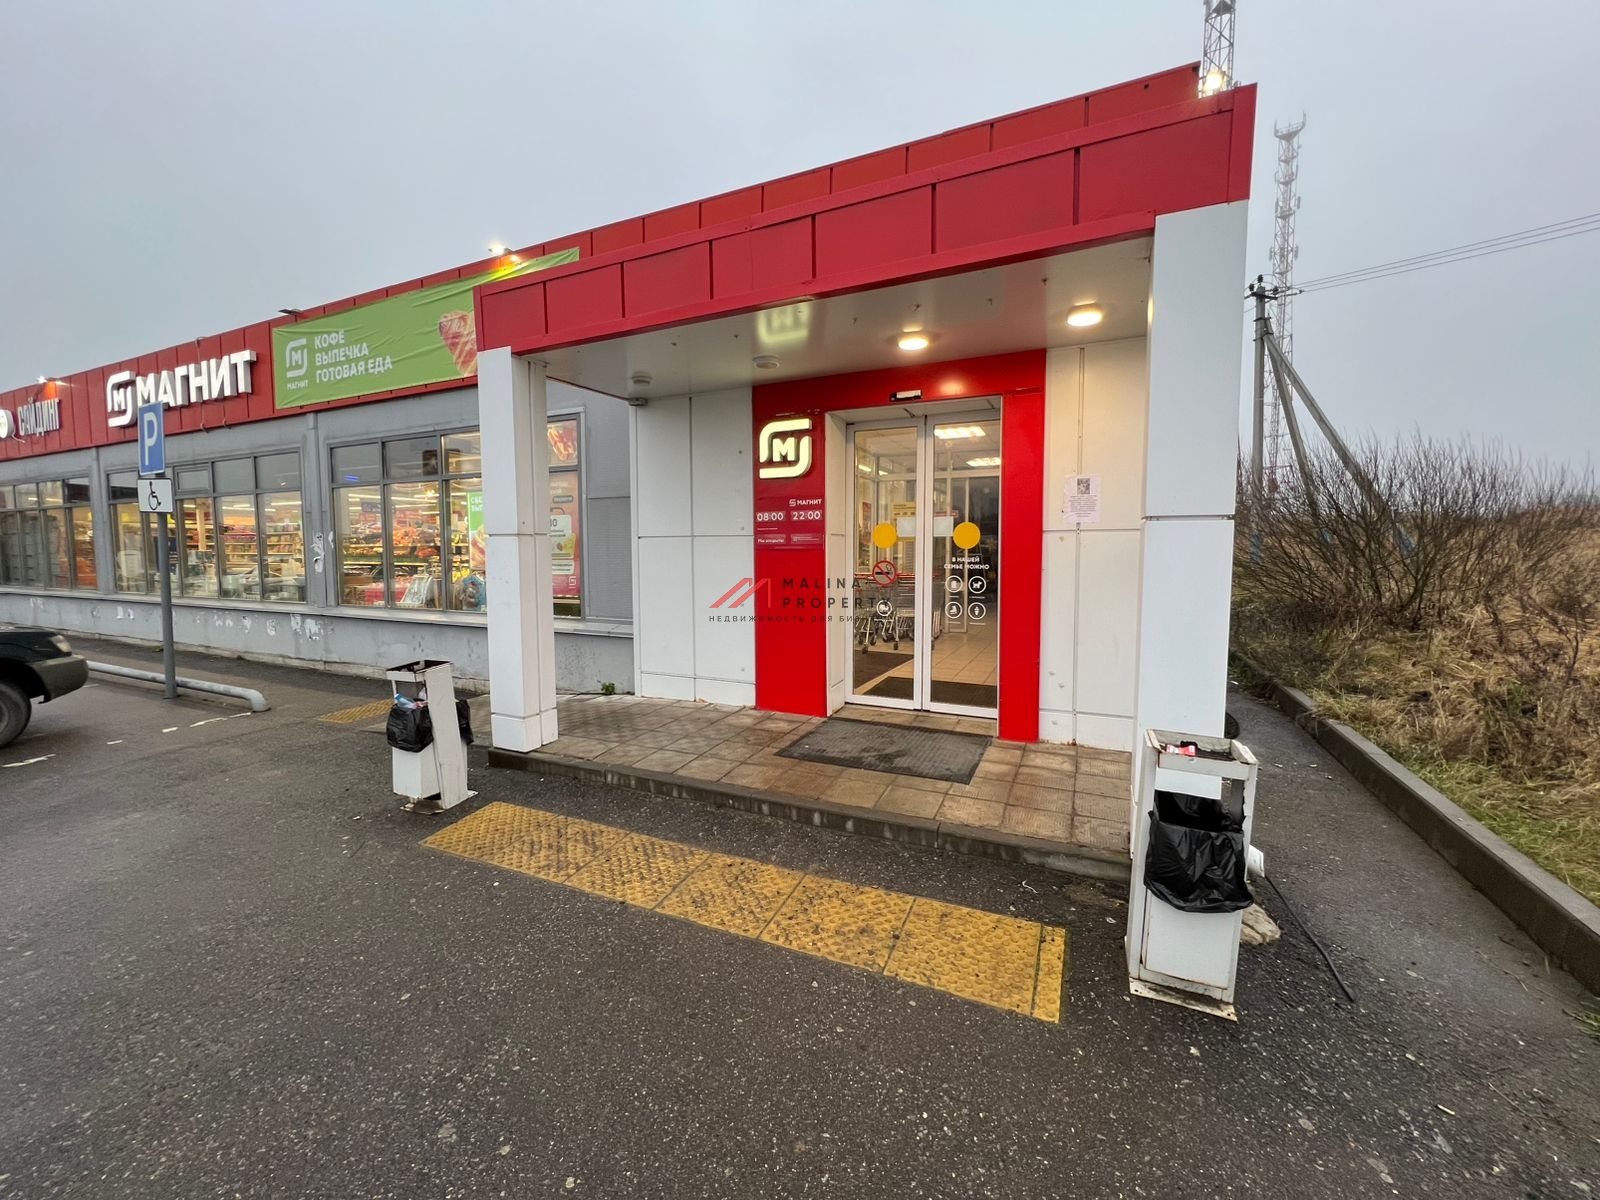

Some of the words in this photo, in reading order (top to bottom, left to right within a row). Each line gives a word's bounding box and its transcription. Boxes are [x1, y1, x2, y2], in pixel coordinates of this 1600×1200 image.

[314, 330, 345, 349] КОФЕ
[315, 342, 369, 366] ВЫПЕЧКА
[136, 349, 257, 409] МАГНИТ
[315, 362, 366, 384] ГОТОВАЯ
[367, 355, 393, 375] ЕДА
[286, 379, 309, 391] МАГНИТ
[143, 411, 159, 466] P
[796, 498, 823, 506] МАГНИТ
[756, 512, 784, 522] 08:00
[792, 510, 821, 520] 22:00
[957, 555, 981, 563] НАШЕЙ
